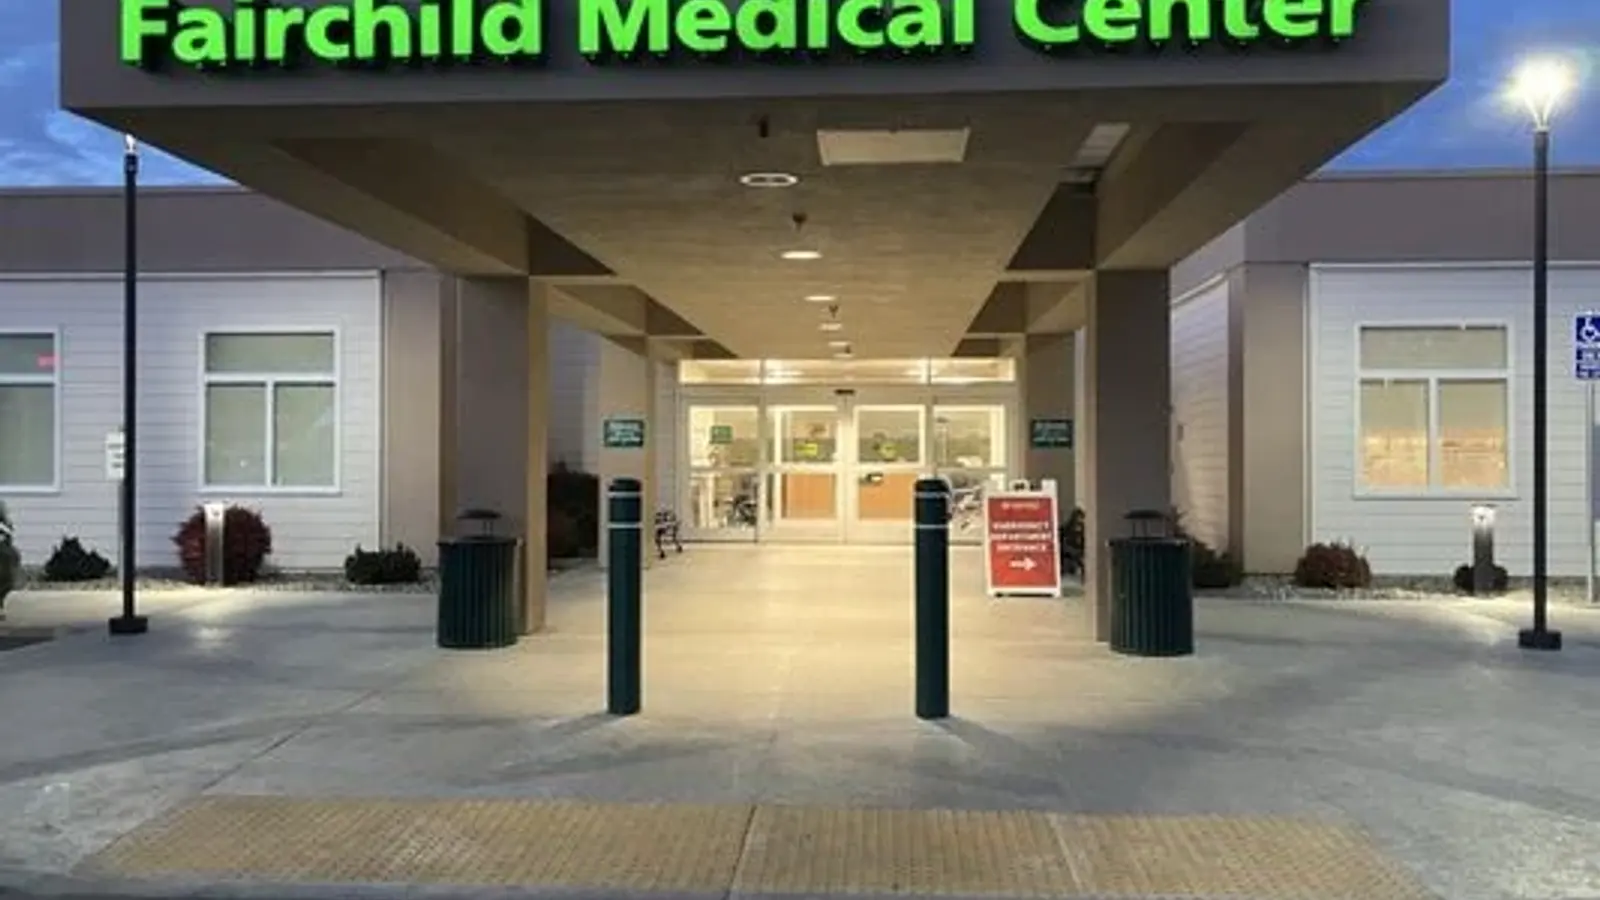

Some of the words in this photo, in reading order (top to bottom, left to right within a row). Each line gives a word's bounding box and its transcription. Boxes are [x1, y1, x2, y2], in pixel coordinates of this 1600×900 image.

[121, 0, 541, 61] Fairchild
[578, 0, 975, 53] Medical
[1014, 0, 1357, 43] Center
